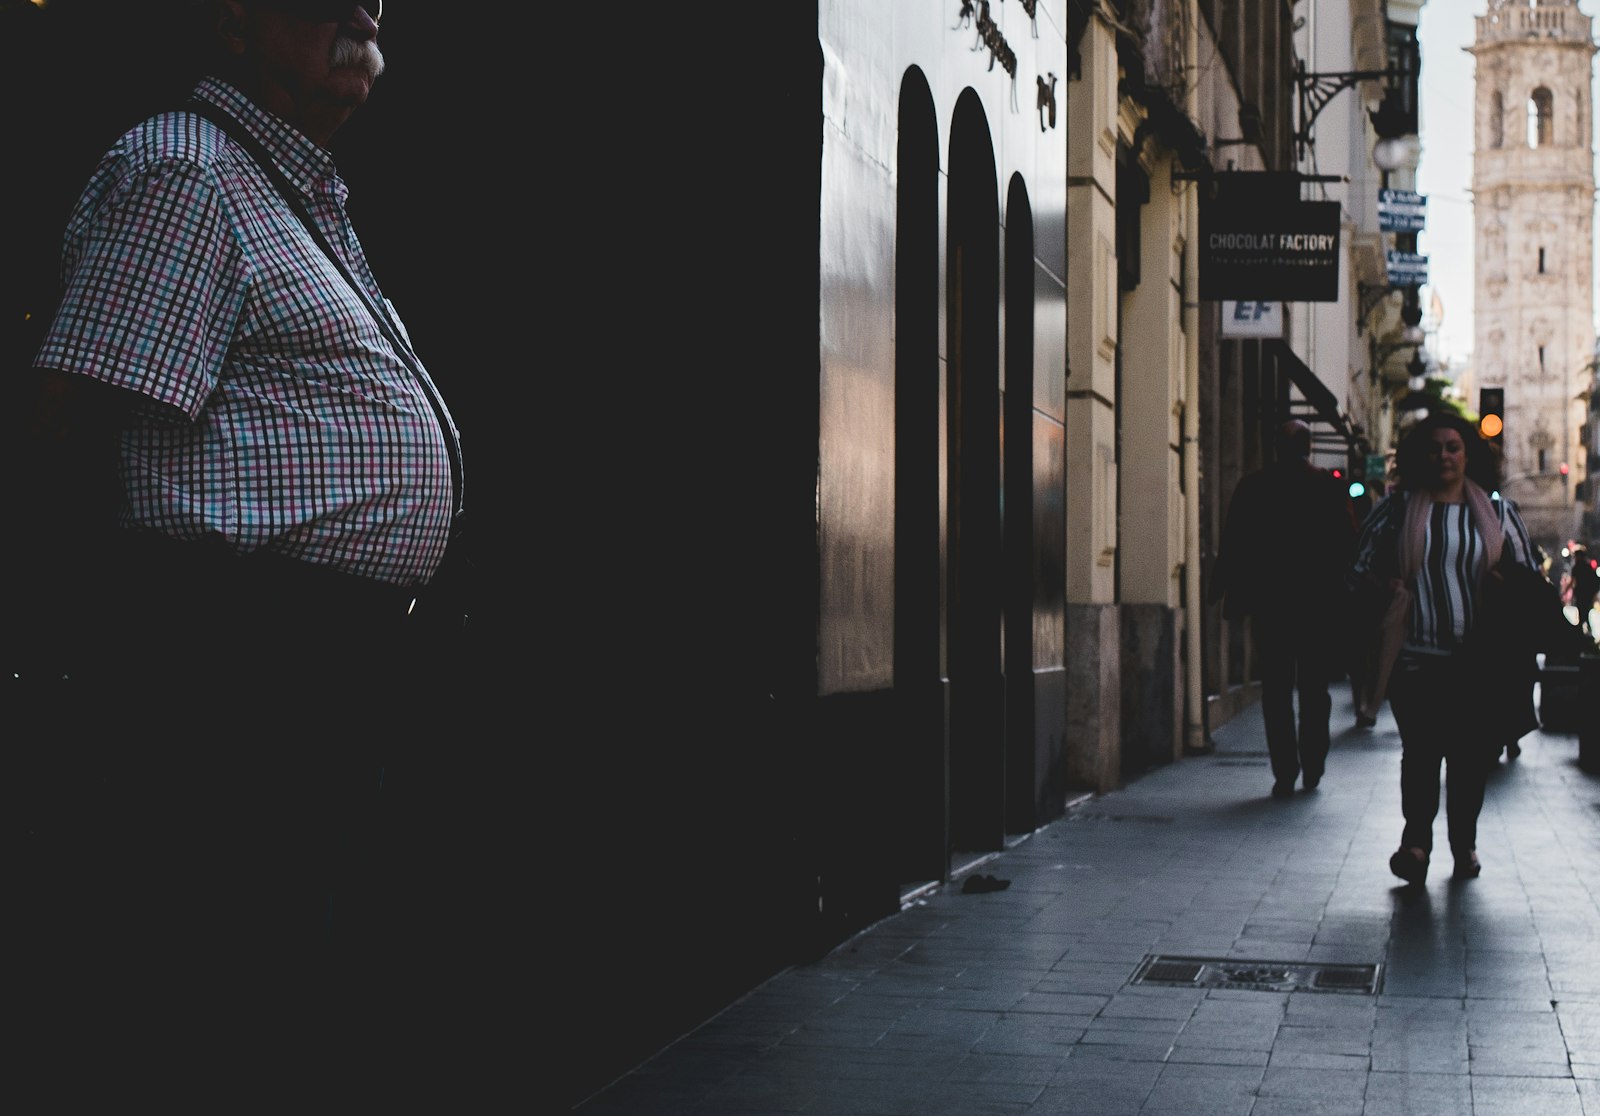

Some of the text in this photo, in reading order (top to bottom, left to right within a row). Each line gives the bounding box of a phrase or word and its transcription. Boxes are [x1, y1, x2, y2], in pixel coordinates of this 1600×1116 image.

[1209, 233, 1335, 251] CHOCOLAT FACTORY
[1234, 300, 1271, 320] EF
